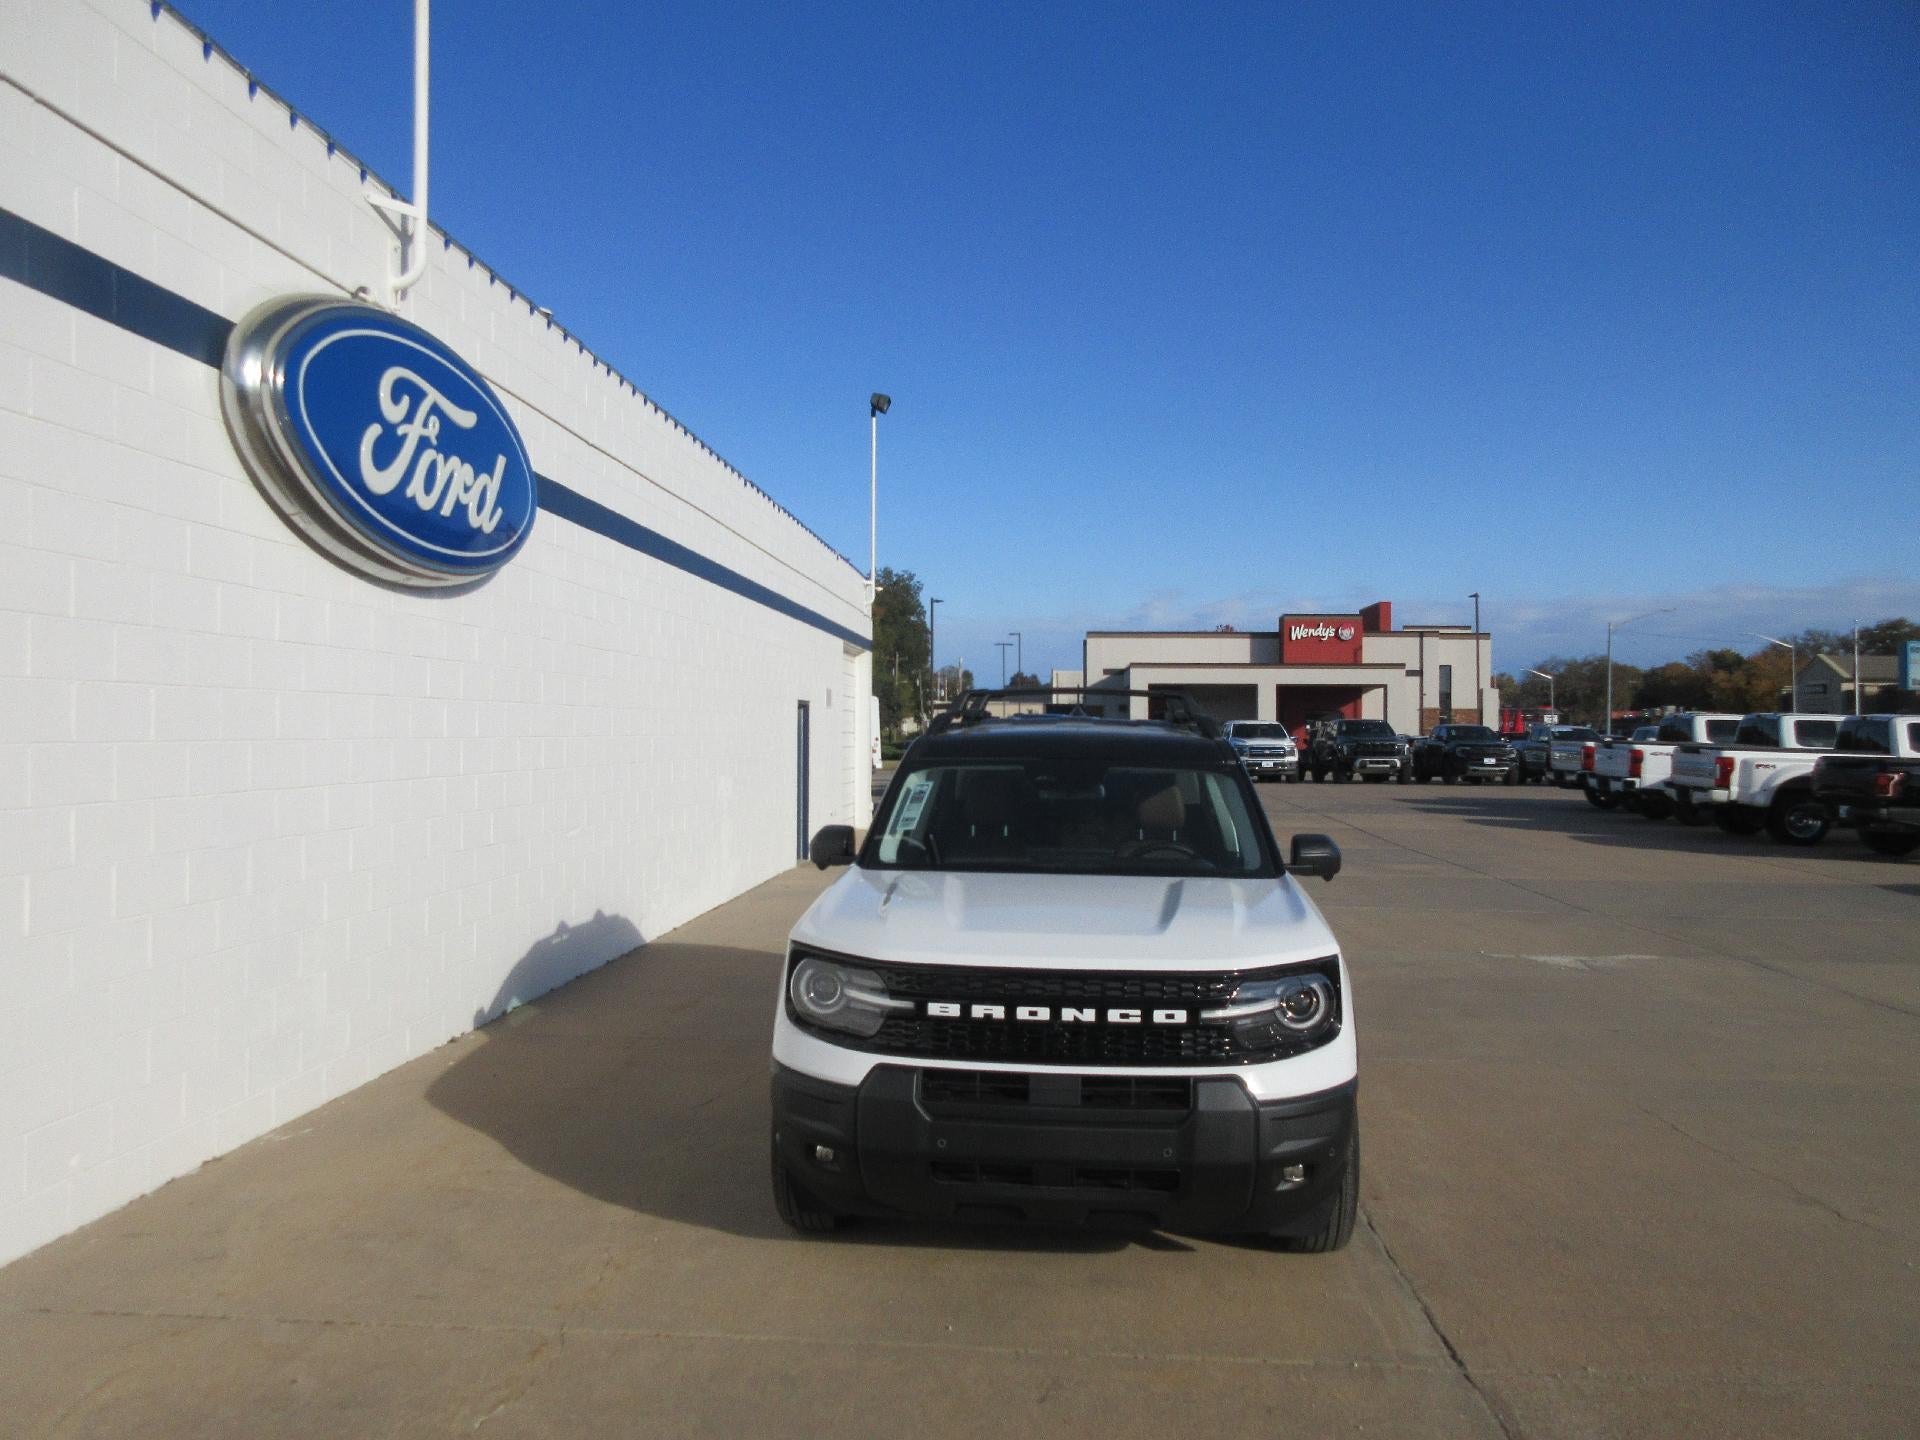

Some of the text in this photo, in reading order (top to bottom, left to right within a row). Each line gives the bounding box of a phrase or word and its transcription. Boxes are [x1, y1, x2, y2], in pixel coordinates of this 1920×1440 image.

[360, 366, 506, 534] Ford
[1291, 622, 1335, 640] Wendy's
[927, 1002, 1187, 1023] BRONCO
